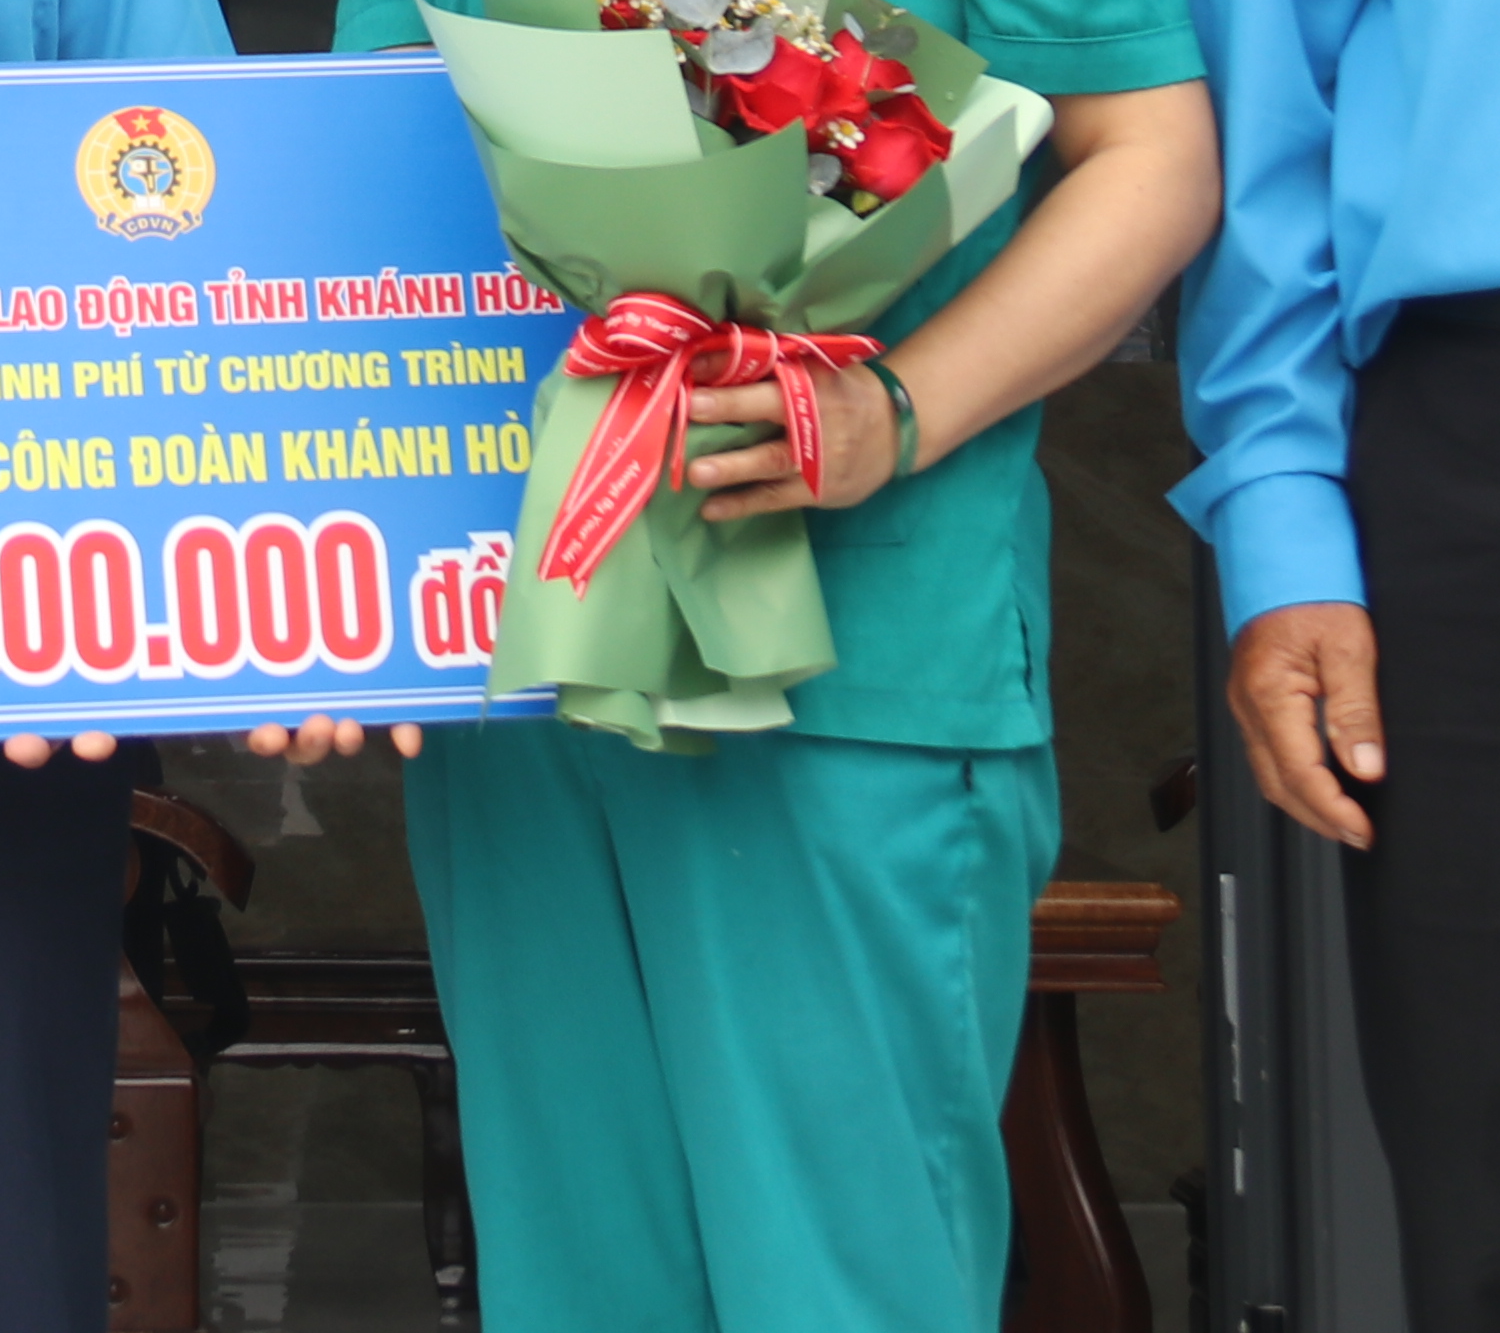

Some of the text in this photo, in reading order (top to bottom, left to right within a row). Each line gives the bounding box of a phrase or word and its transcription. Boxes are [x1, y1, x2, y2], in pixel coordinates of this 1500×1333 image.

[76, 276, 197, 336] ĐỘNG
[205, 268, 308, 324] TỈNH
[315, 268, 464, 320] KHÁNH
[472, 262, 564, 315] HÒA
[73, 352, 144, 397] PHÍ
[154, 351, 209, 395] TỪ
[219, 349, 391, 393] CHƯƠNG
[401, 341, 526, 386] TRÌNH
[129, 423, 268, 487] ĐOÀN
[281, 418, 452, 481] KHÁNH
[464, 410, 532, 475] HÒ
[412, 533, 508, 665] đồ
